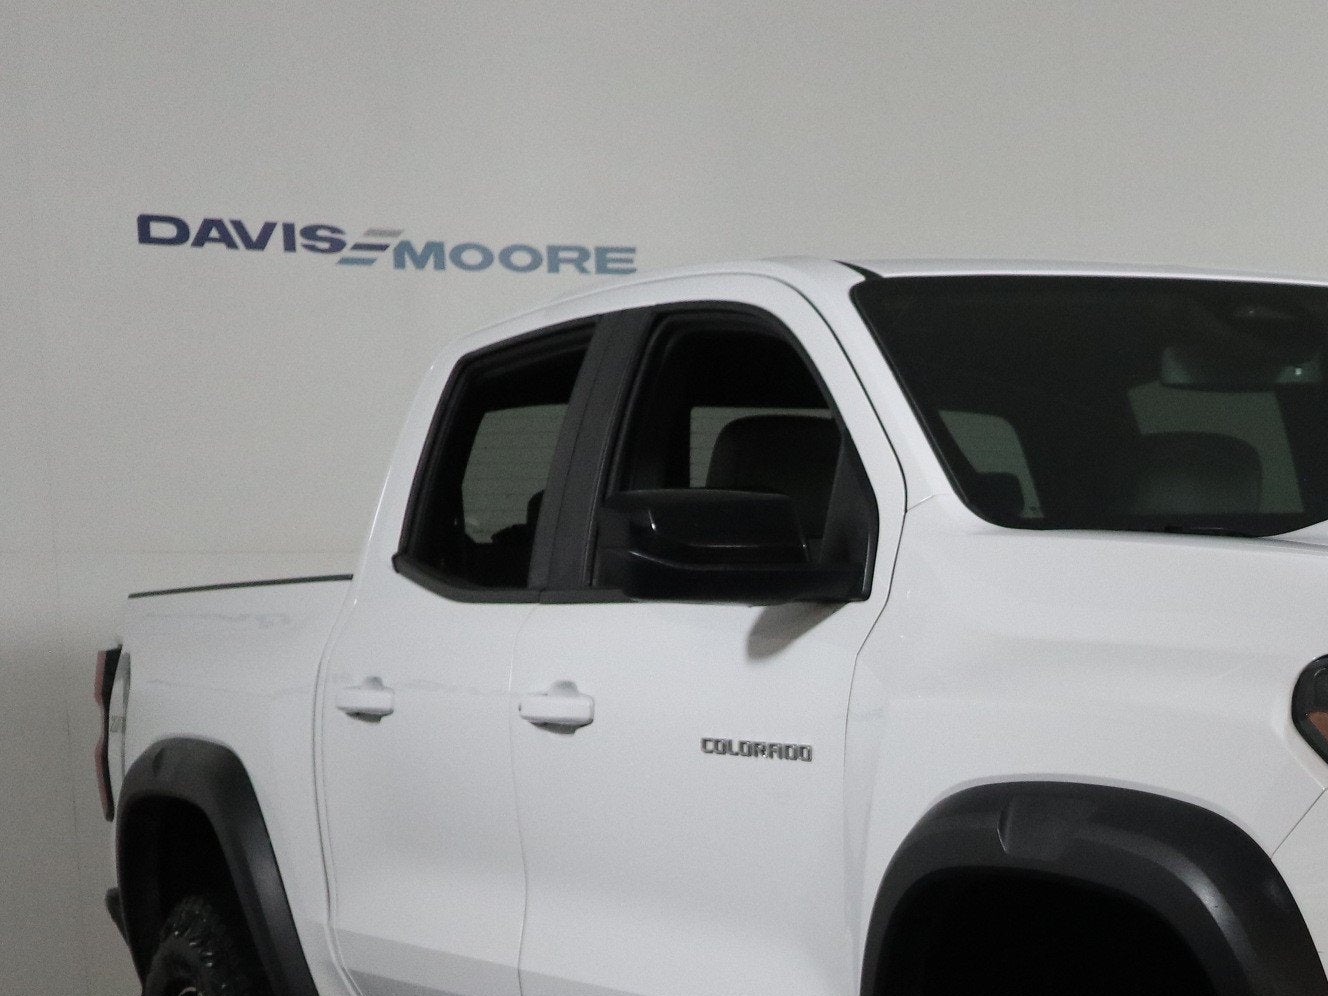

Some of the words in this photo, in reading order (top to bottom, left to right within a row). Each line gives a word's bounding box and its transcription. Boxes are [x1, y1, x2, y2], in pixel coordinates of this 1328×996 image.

[136, 213, 347, 255] DAVIS
[392, 241, 638, 276] MOORE
[700, 737, 813, 763] COLORADO
